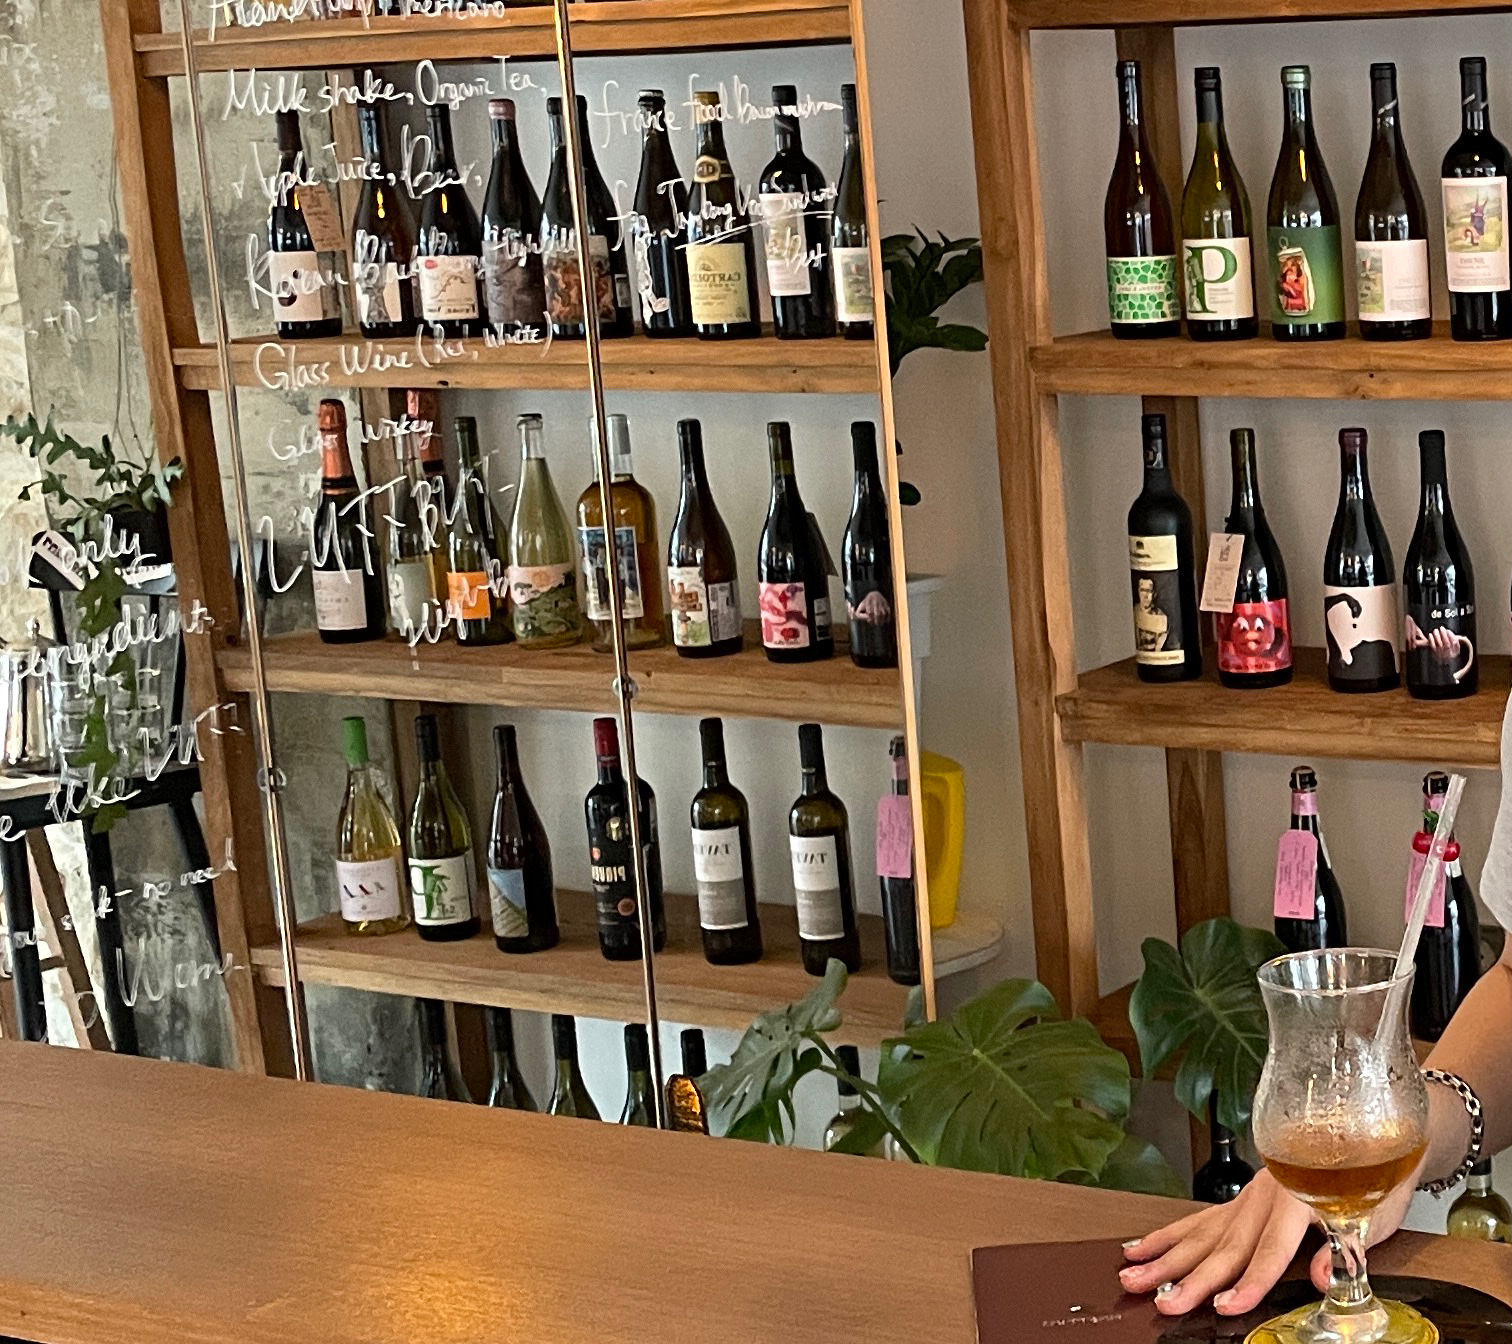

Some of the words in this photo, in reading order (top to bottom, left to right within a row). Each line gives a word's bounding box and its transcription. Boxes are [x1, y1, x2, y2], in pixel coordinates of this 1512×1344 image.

[221, 68, 311, 121] Milk
[415, 58, 495, 111] Organic
[254, 341, 332, 391] Glass
[340, 342, 414, 377] Wine
